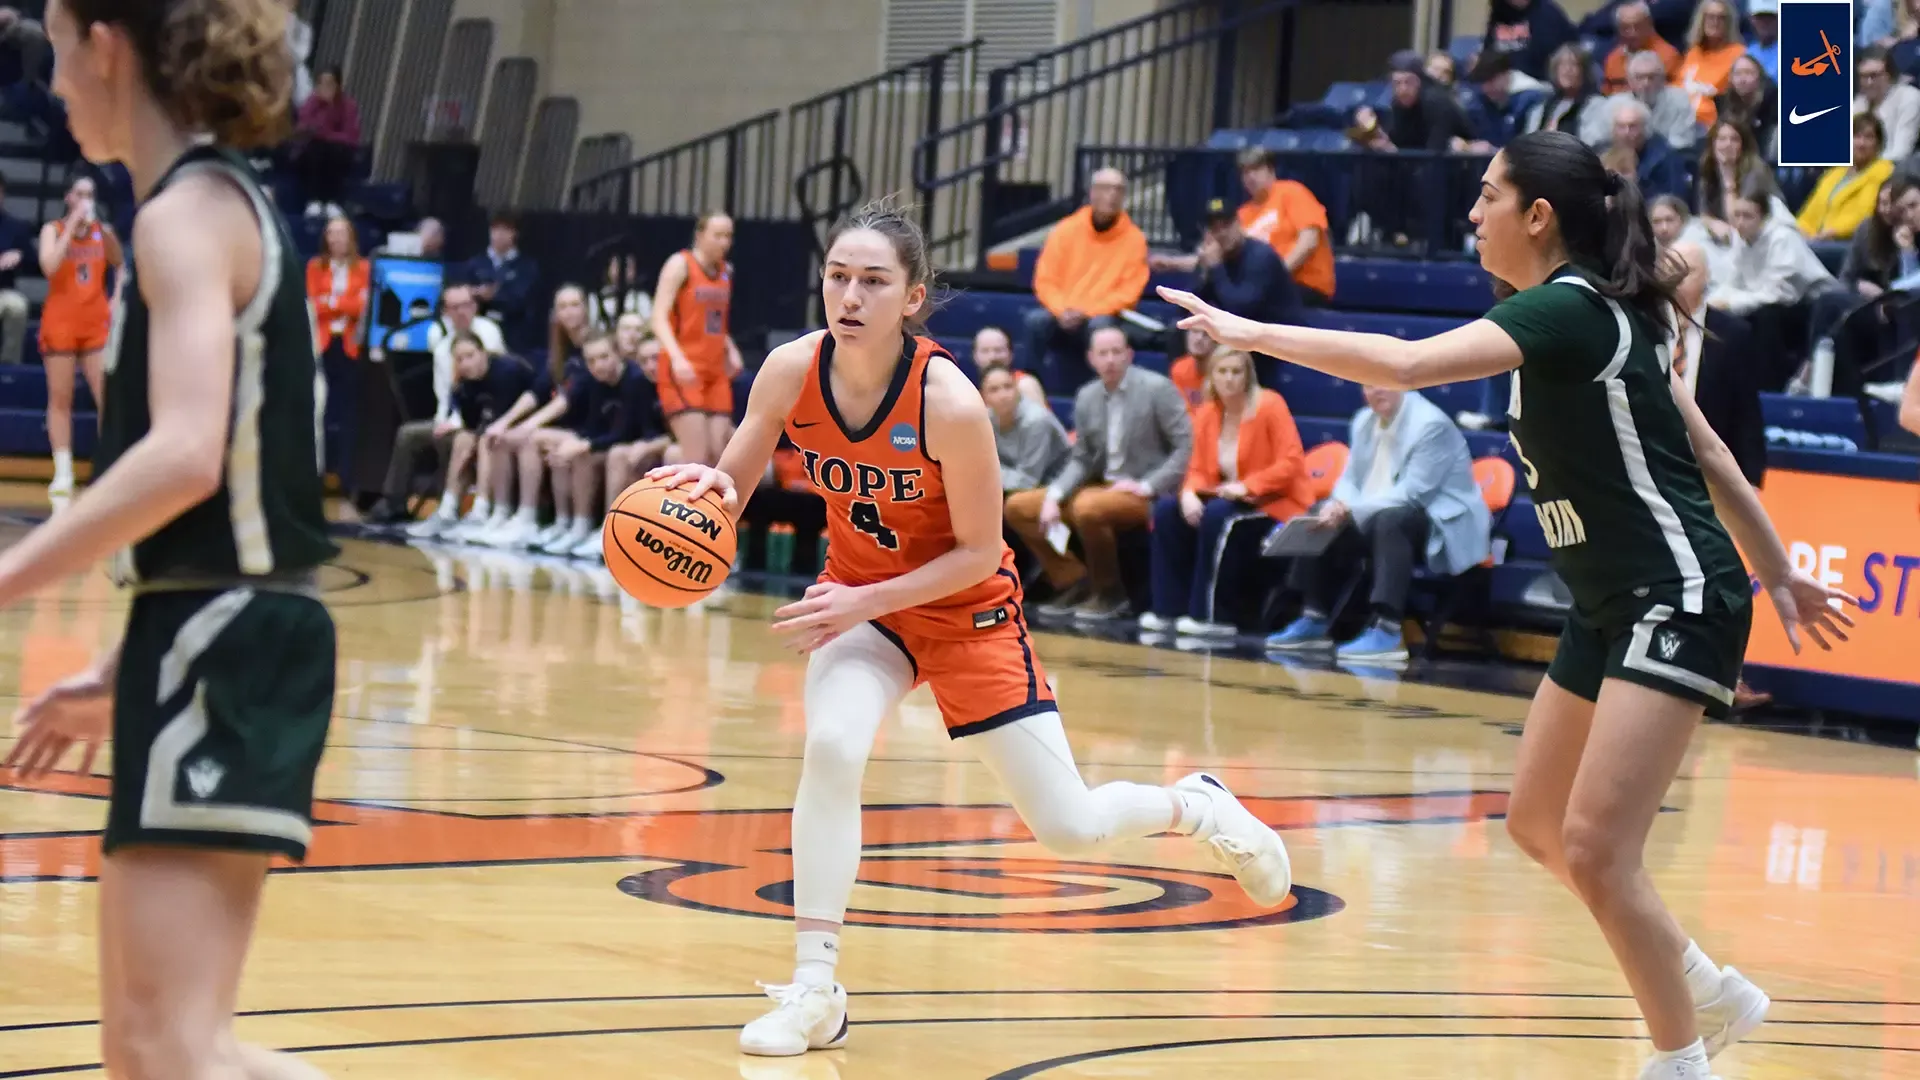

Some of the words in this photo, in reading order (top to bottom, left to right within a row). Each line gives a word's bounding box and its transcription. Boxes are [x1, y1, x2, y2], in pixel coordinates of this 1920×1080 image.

[891, 435, 917, 446] NCAA
[659, 498, 722, 542] NCAA
[848, 499, 901, 552] 4
[634, 526, 713, 584] Wilson
[1857, 551, 1920, 618] ST
